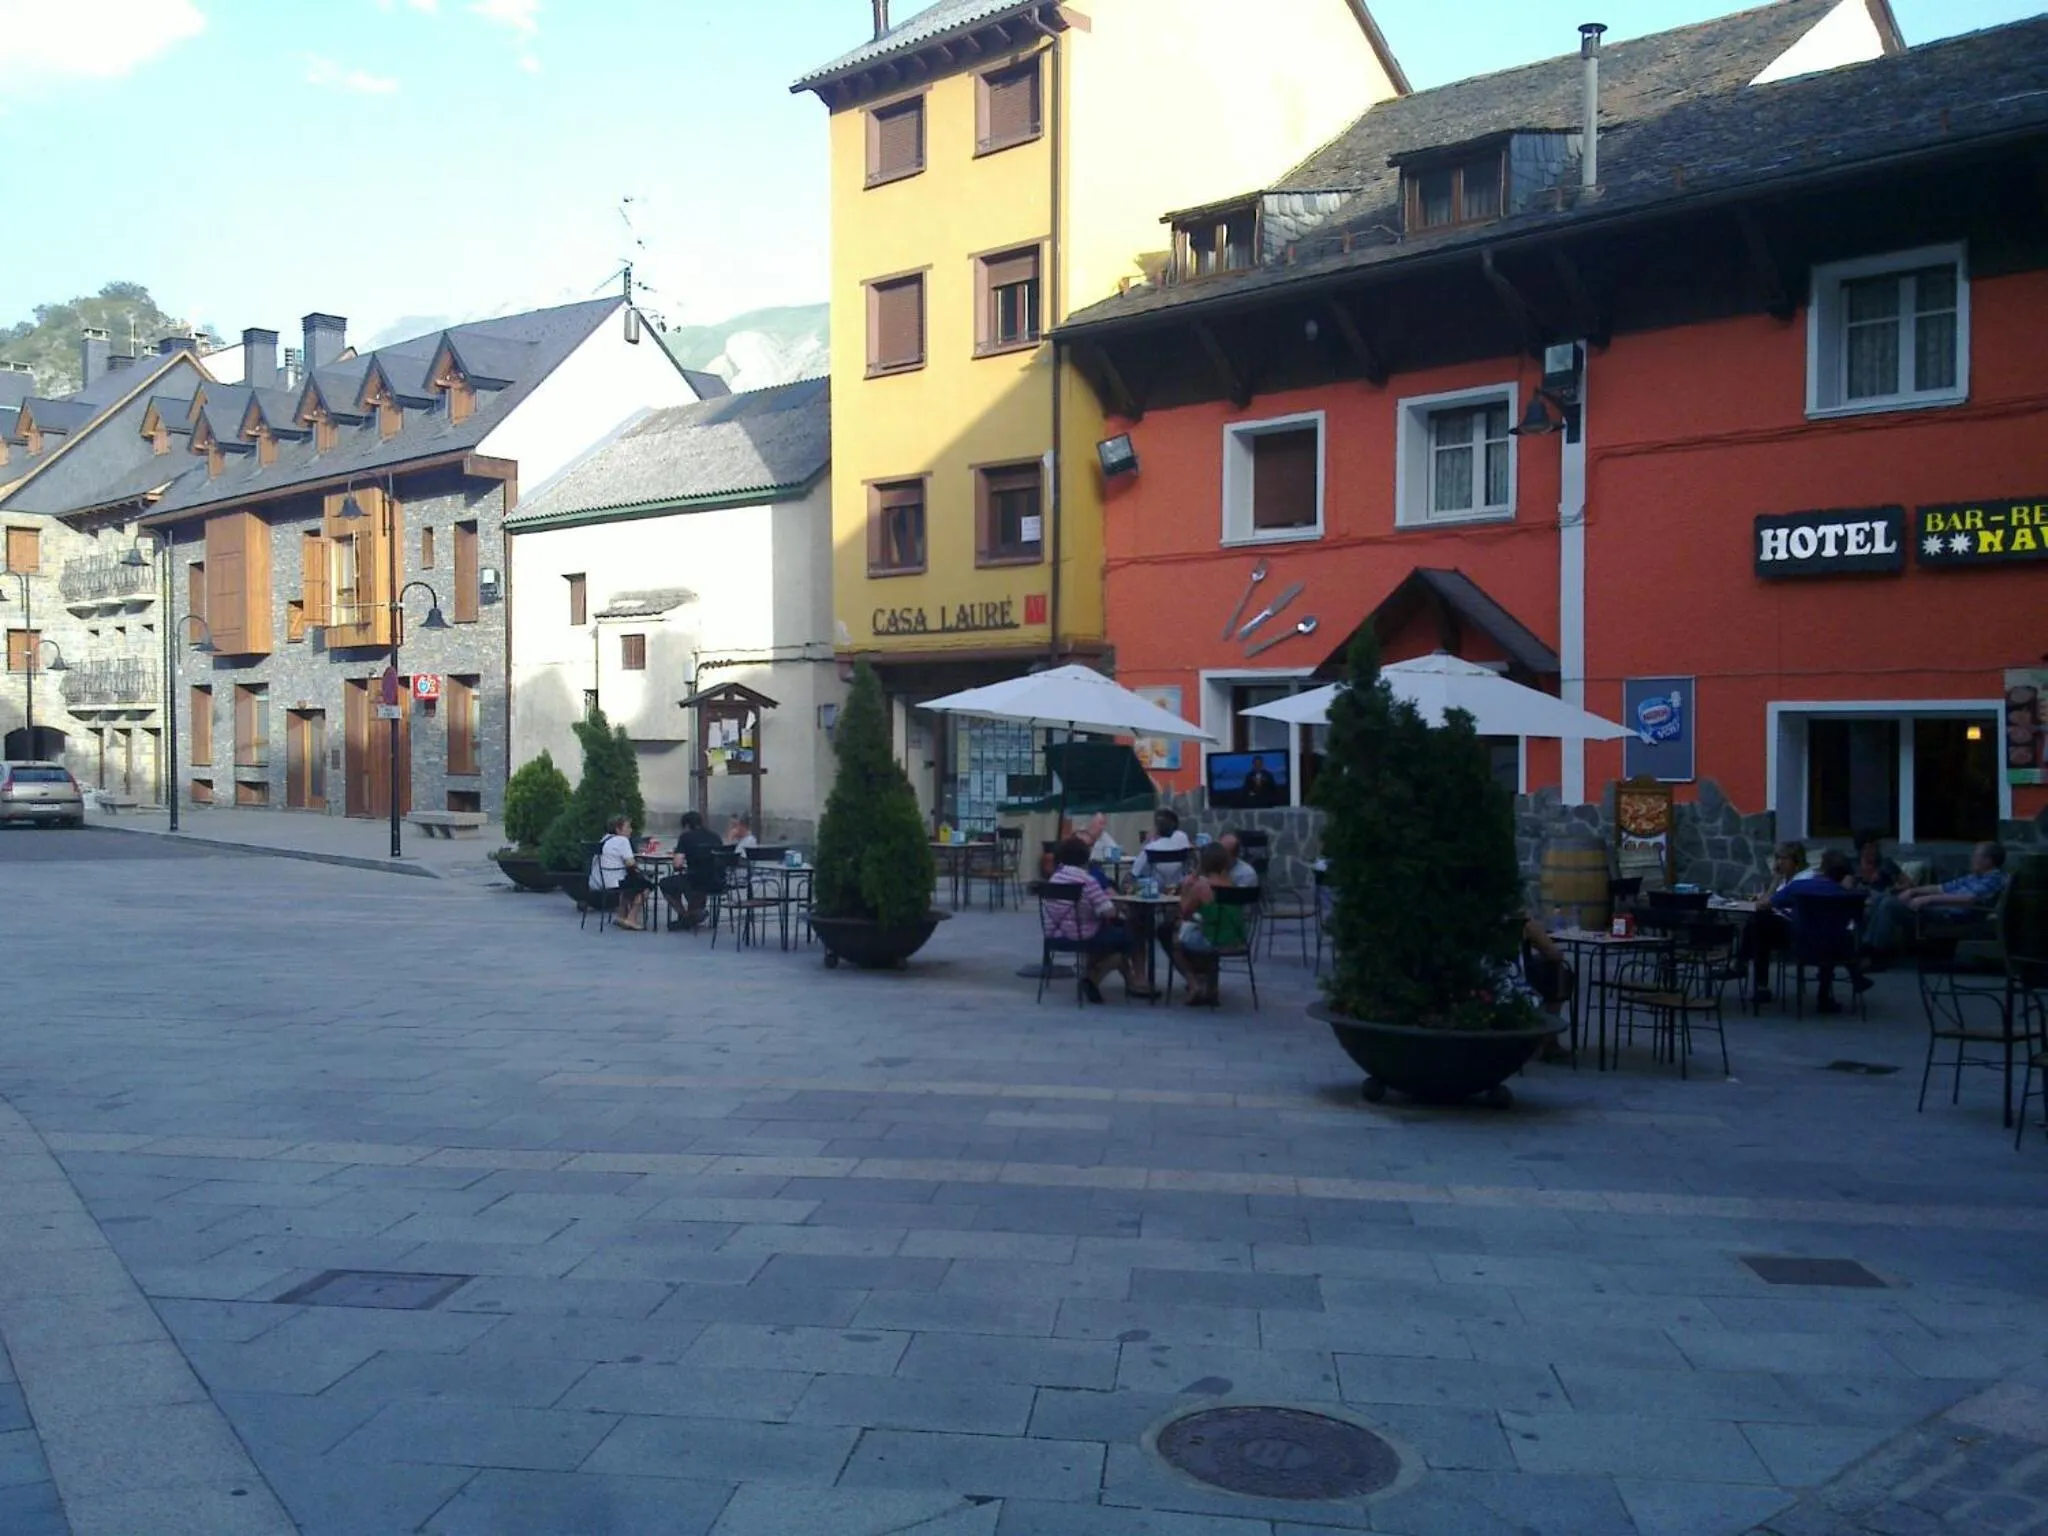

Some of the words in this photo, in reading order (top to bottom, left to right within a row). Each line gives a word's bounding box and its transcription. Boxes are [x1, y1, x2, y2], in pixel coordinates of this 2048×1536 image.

[1760, 521, 1897, 561] HOTEL
[872, 607, 927, 633] CASA
[940, 594, 1016, 631] LAURÉ
